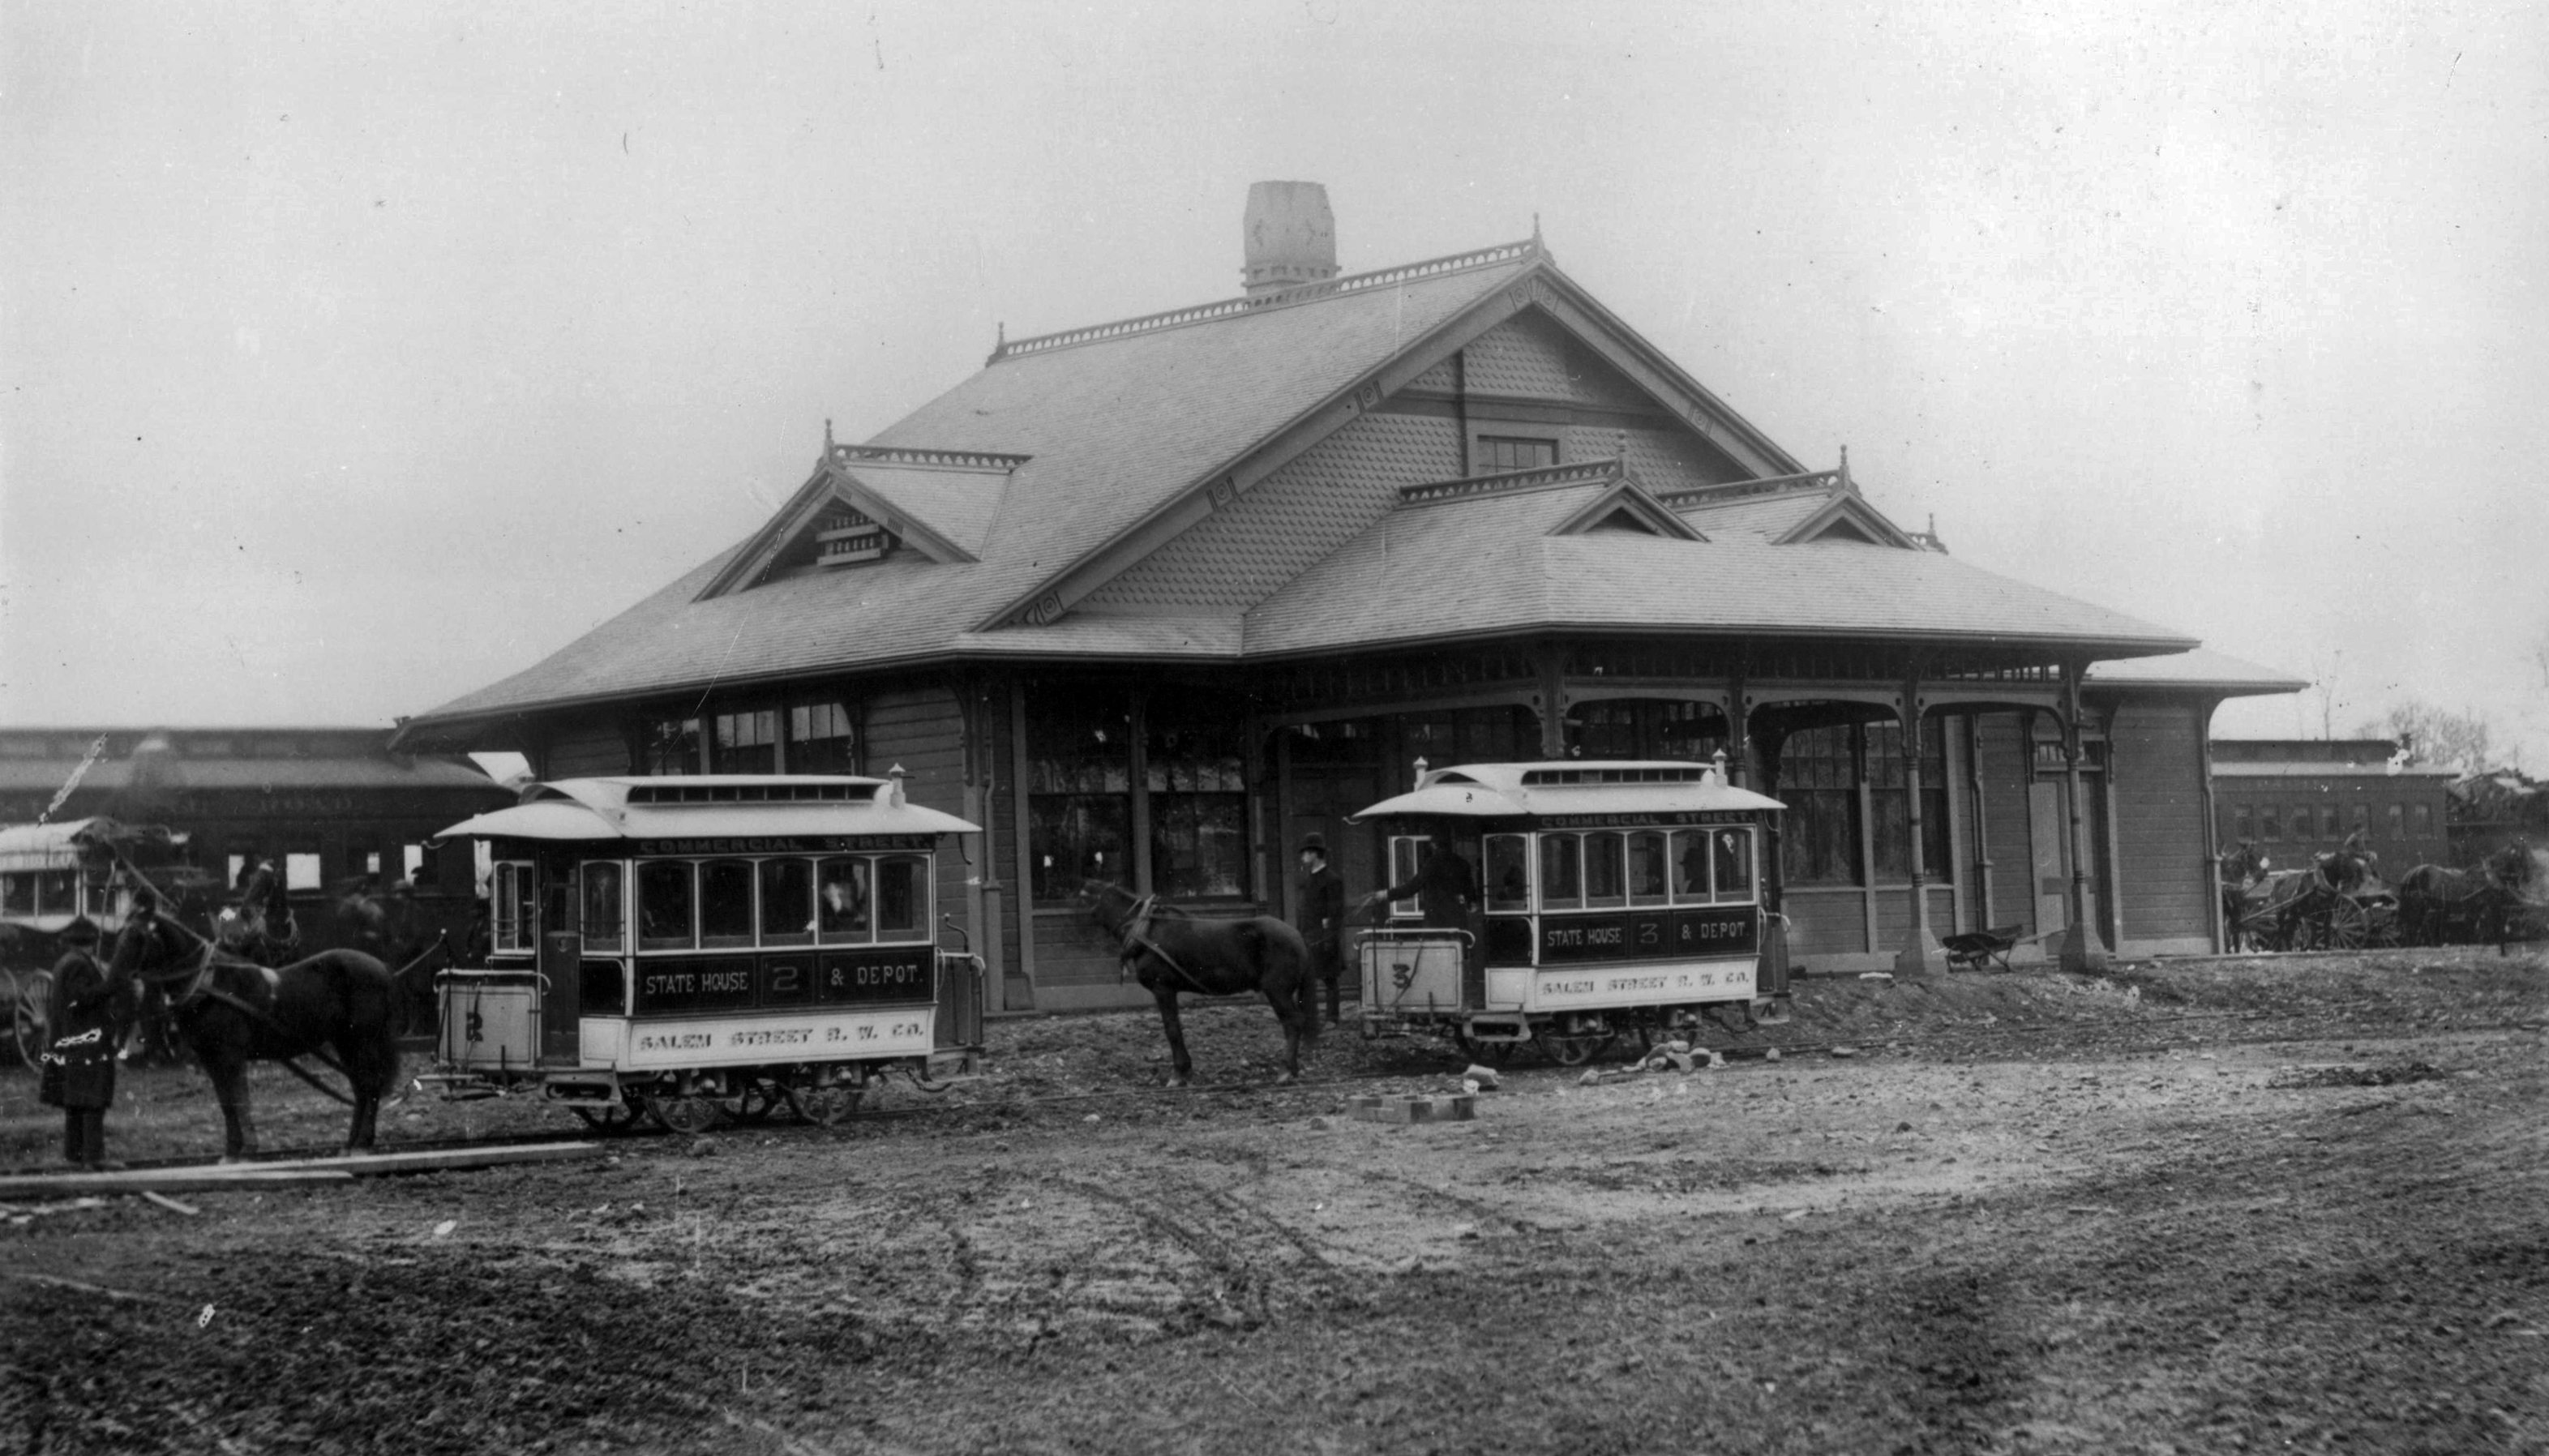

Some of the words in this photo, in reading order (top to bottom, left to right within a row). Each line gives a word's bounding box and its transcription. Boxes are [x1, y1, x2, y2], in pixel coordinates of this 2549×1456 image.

[1542, 813, 1660, 827] COMMERCIAL
[640, 838, 804, 854] COMMERCIAL
[1547, 929, 1583, 947] STATE
[1587, 927, 1622, 944] HOUSE
[1640, 923, 1659, 944] 3
[1681, 924, 1691, 940] &
[645, 974, 696, 994] STATE
[701, 972, 748, 993] HOUSE
[773, 966, 799, 990] 2
[831, 968, 844, 986] &
[1392, 963, 1411, 989] 3
[1543, 981, 1593, 995] SALEM
[1608, 976, 1668, 991] STREET
[640, 1034, 712, 1051] SALEM
[731, 1029, 813, 1046] STREET
